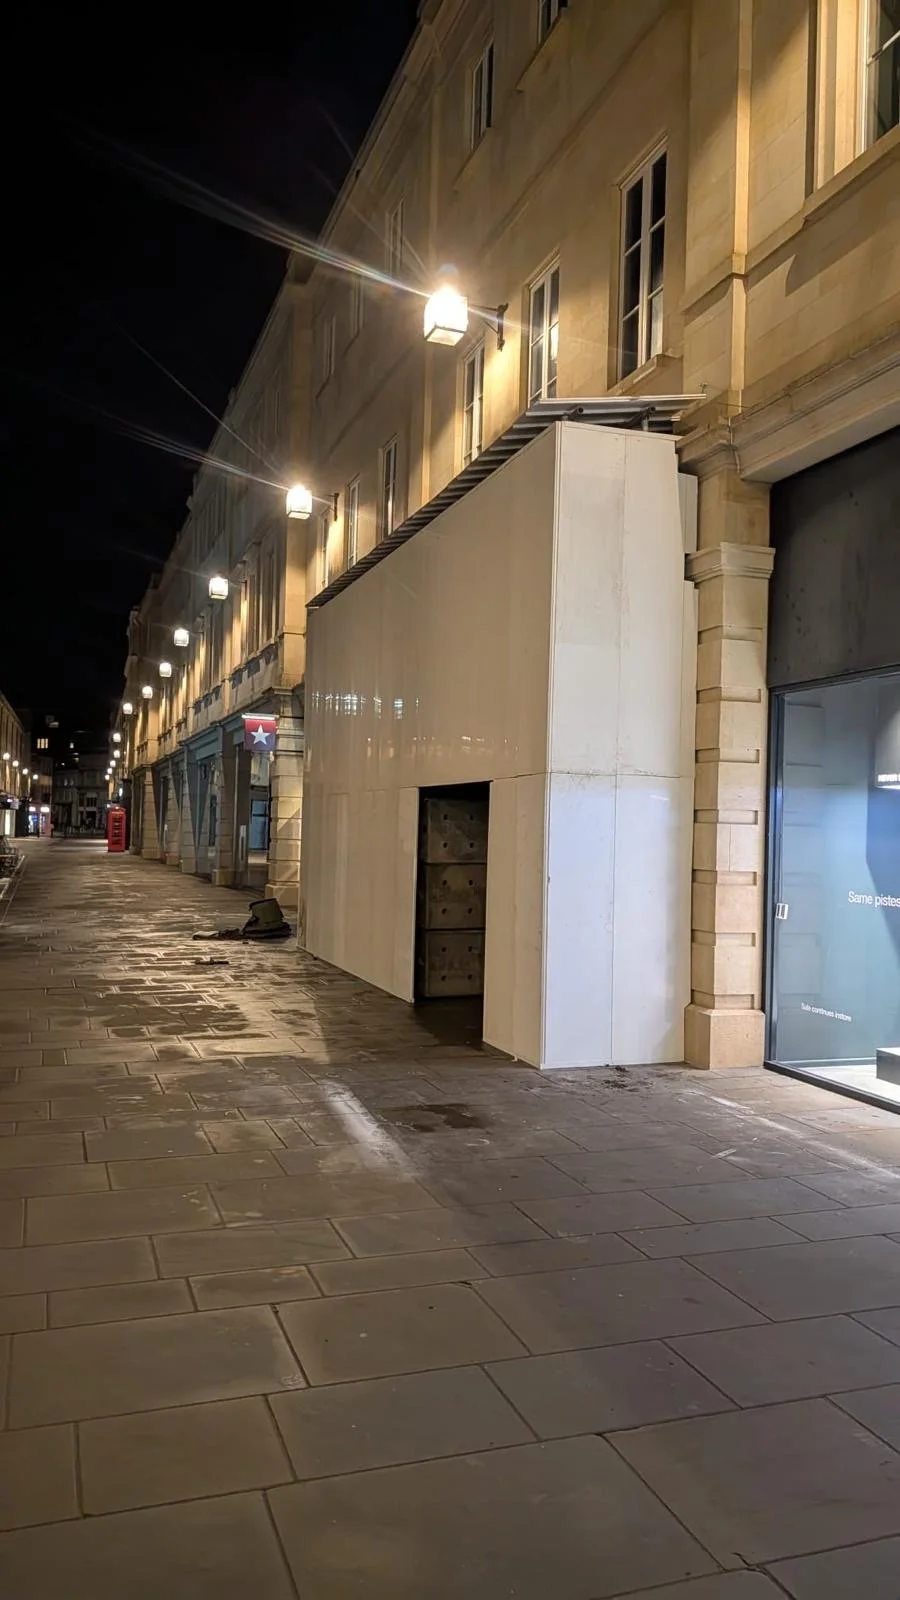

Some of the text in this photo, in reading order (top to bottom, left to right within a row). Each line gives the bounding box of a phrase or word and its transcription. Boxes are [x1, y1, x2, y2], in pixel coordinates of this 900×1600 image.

[848, 890, 900, 907] Same pistes
[812, 1007, 834, 1017] continues
